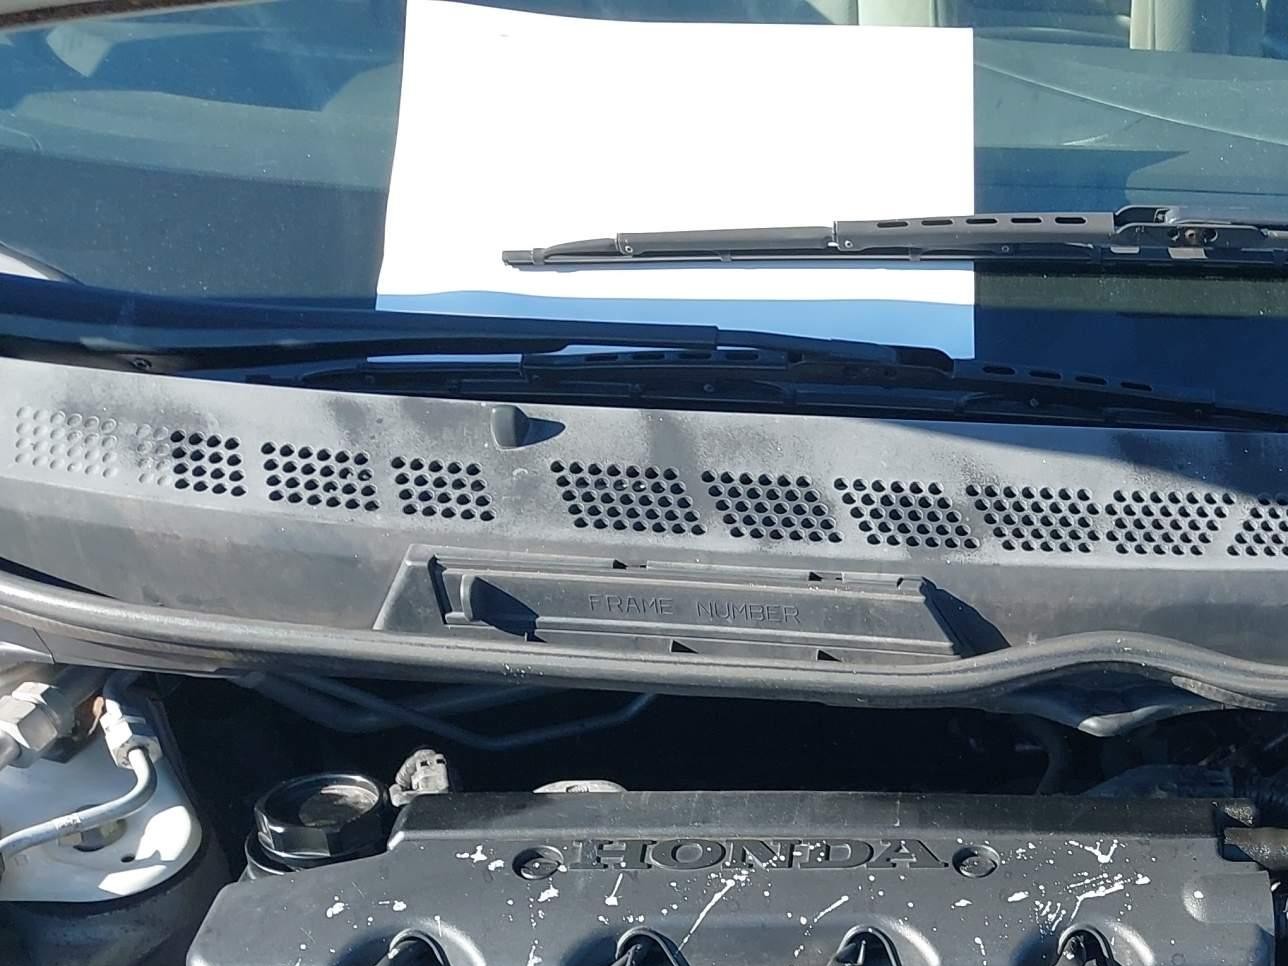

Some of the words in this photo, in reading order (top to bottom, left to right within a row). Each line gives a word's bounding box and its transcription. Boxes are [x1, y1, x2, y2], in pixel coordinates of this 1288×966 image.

[588, 593, 673, 616] FRAME
[697, 601, 801, 624] NUMBER
[570, 838, 948, 870] HONDA
